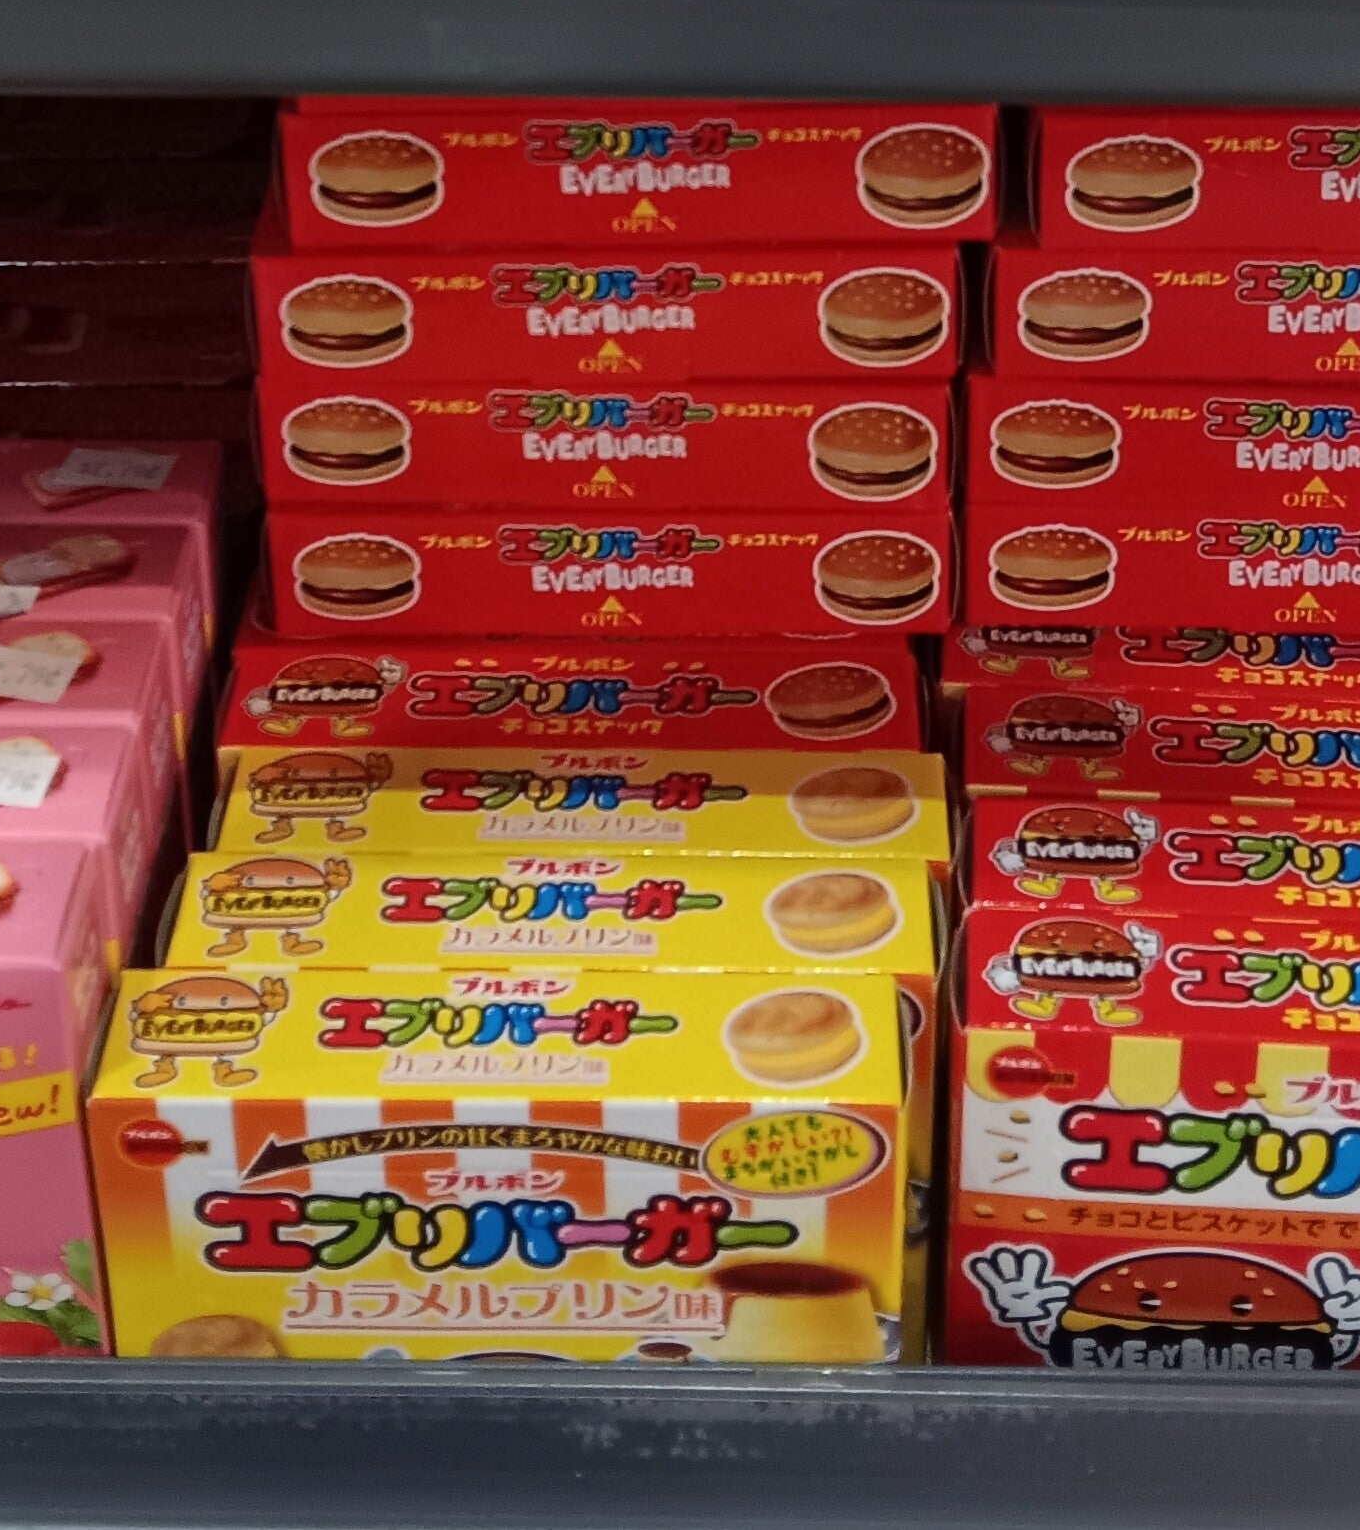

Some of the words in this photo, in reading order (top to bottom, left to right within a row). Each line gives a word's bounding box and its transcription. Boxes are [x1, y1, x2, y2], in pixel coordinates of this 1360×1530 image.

[382, 878, 724, 925] エブリバーガー
[318, 997, 680, 1050] エブリバーガー
[423, 1169, 564, 1195] ブルボン
[196, 1188, 801, 1275] エブリバーガー
[285, 1280, 724, 1328] カラメルプリン味
